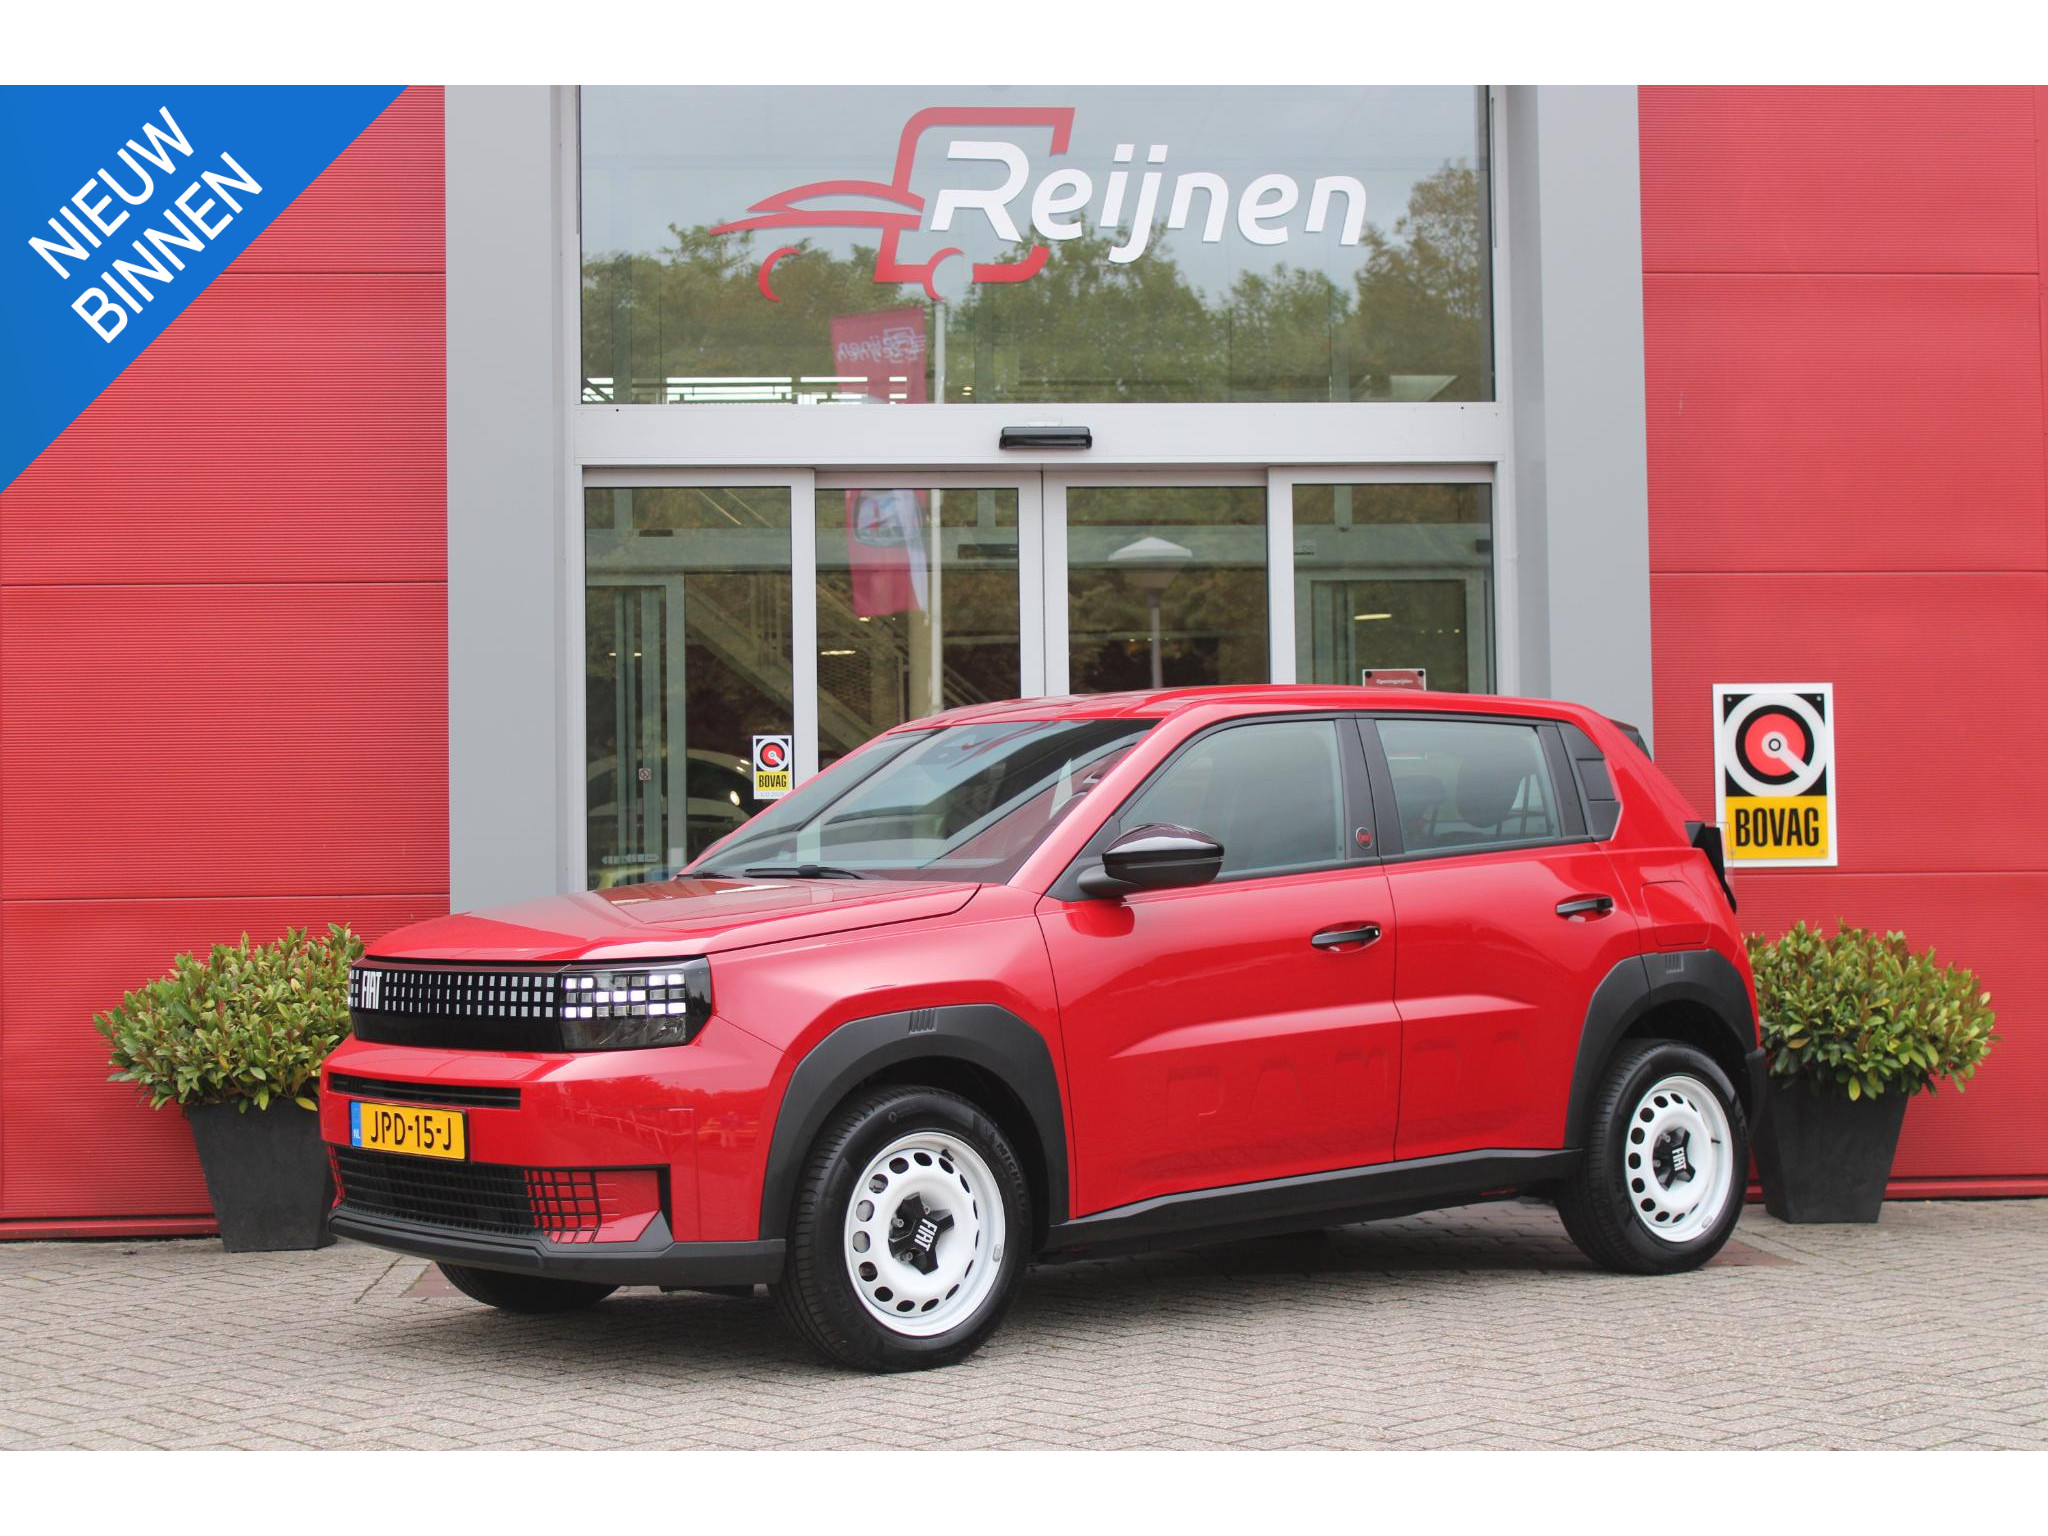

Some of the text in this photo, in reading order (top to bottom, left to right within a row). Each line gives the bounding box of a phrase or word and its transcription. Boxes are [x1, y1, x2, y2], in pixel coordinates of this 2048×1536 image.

[929, 140, 1368, 263] Reijnen
[758, 774, 787, 788] BOVAG
[1734, 807, 1820, 848] BOVAG
[361, 970, 382, 1010] FIAT
[353, 1129, 361, 1139] NL
[370, 1110, 452, 1151] JPD-15-J
[1671, 1146, 1687, 1172] FIAT
[914, 1218, 938, 1252] FIAT
